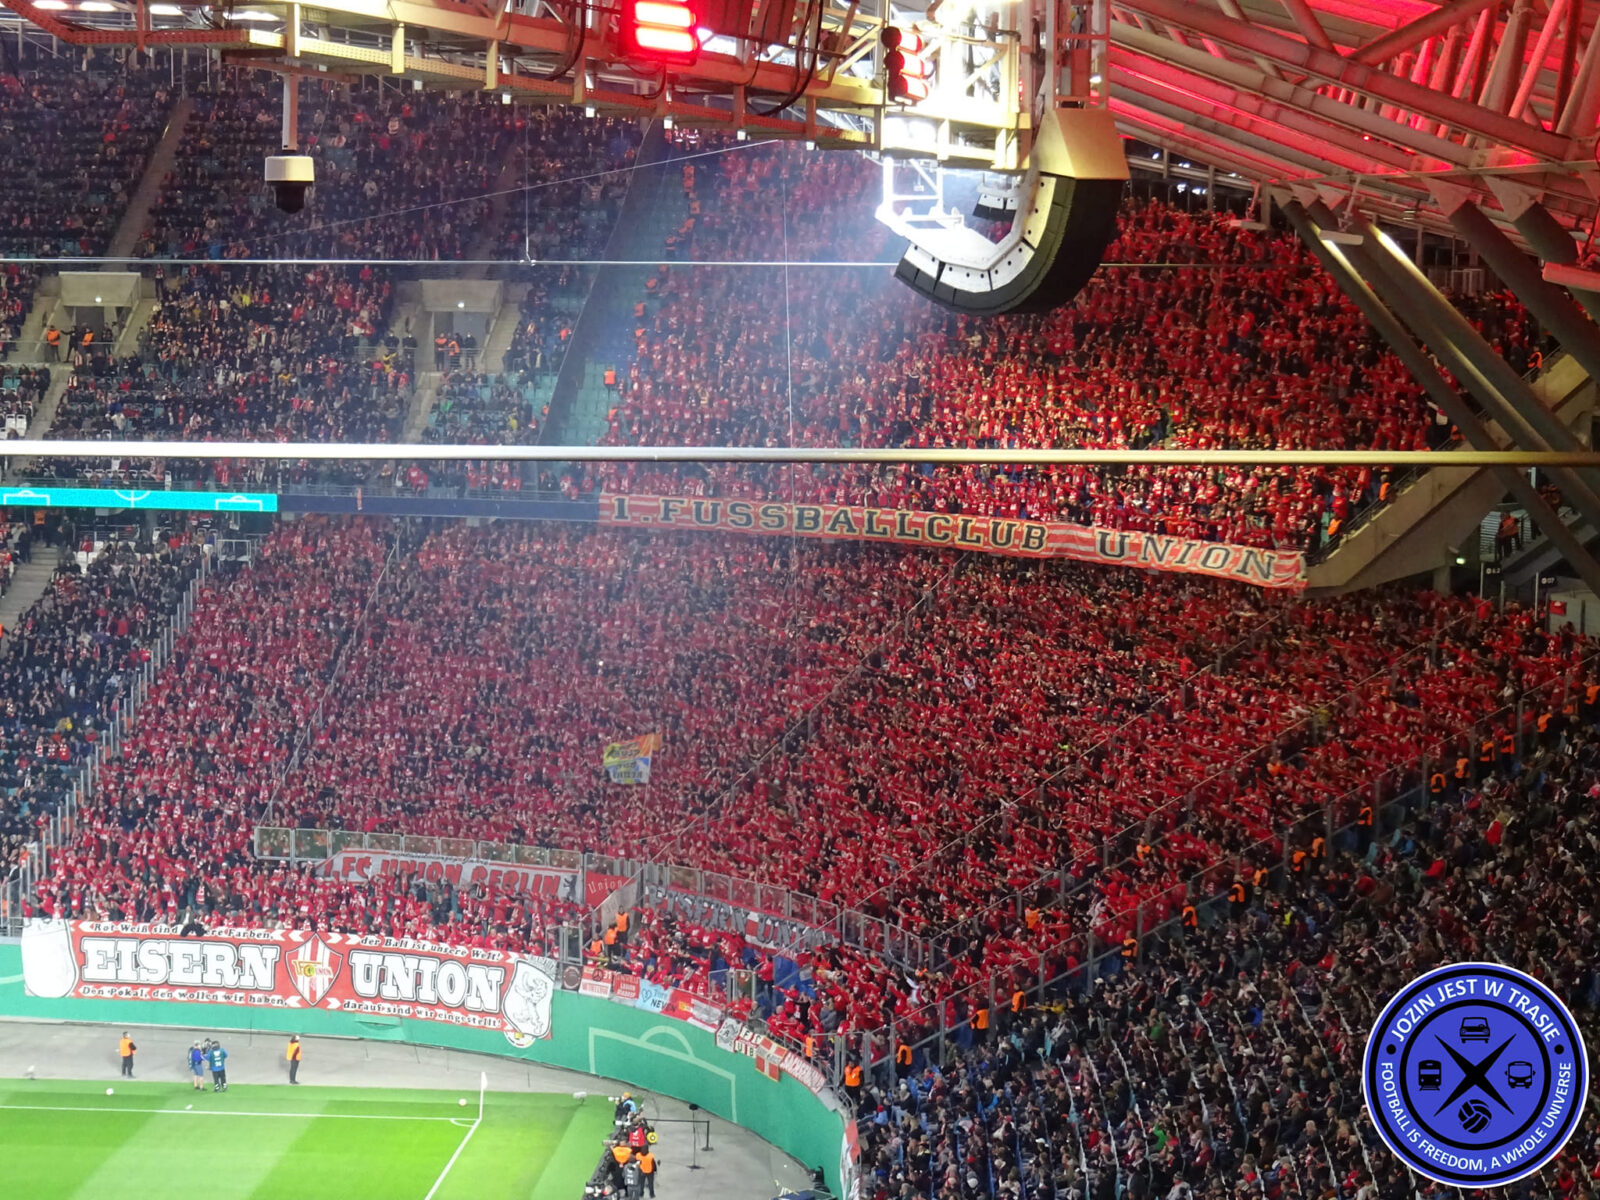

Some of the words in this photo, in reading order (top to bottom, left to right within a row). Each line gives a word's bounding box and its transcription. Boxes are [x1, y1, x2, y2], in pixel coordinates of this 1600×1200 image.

[1095, 528, 1276, 581] UNION
[380, 858, 463, 886] UNION
[470, 866, 561, 897] BERLIN
[588, 878, 623, 894] Union
[153, 926, 178, 934] sind
[360, 938, 381, 946] der
[384, 939, 408, 949] Ball
[411, 941, 428, 951] ist
[430, 945, 467, 956] unsere
[472, 949, 501, 961] Welt!
[80, 936, 281, 991] EISERN
[348, 949, 505, 1014] UNION
[82, 986, 104, 995] Den
[152, 989, 173, 998] den
[178, 991, 219, 1000] wollen
[223, 993, 244, 1002] wir
[343, 1000, 382, 1010] darauf
[386, 1004, 411, 1015] sind
[416, 1009, 434, 1018] wir
